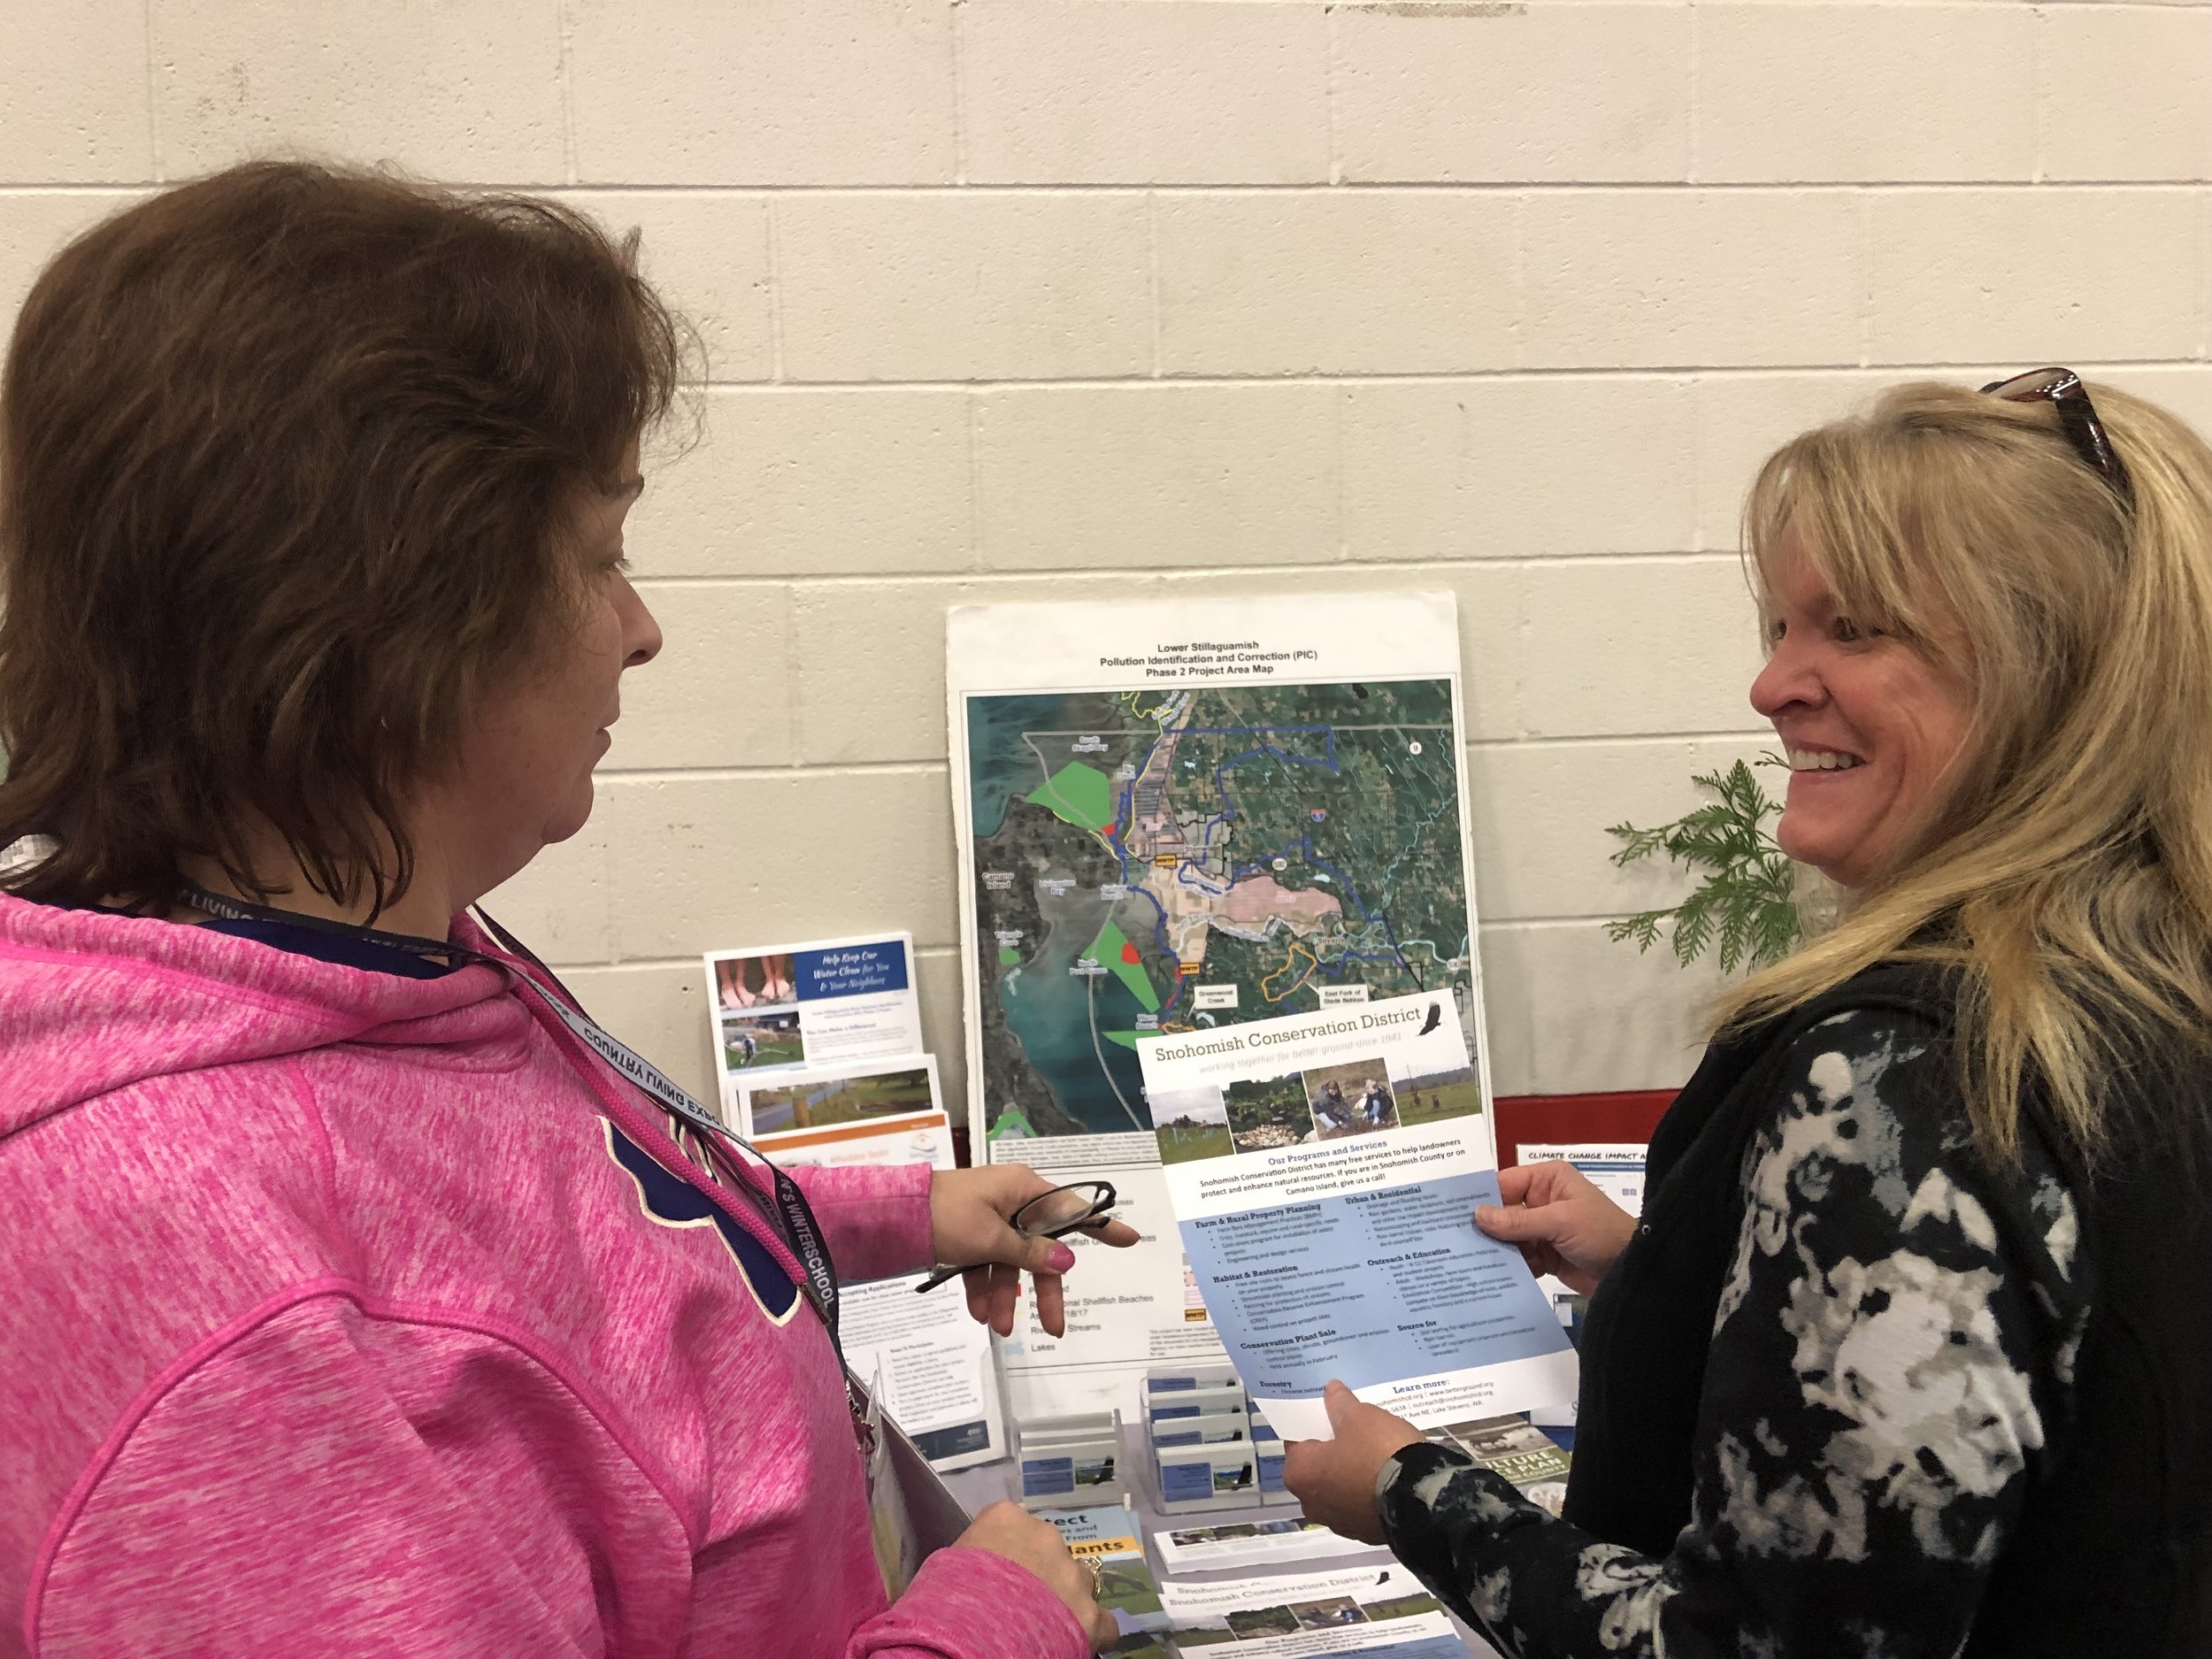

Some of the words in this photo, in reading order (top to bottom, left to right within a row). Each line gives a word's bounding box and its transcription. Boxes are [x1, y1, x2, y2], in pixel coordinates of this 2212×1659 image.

[1157, 644, 1188, 653] Lower
[1191, 641, 1259, 652] Stillaguamish
[1100, 657, 1145, 666] Pollution
[1148, 654, 1213, 665] Identification
[1216, 654, 1235, 663] and
[1237, 652, 1290, 662] Correction
[1293, 650, 1317, 661] (PIC)
[1146, 667, 1177, 677] Phase
[1179, 667, 1187, 676] 2
[1188, 666, 1224, 678] Project
[1226, 665, 1249, 674] Area
[1252, 664, 1273, 675] Map
[822, 953, 840, 966] Help
[841, 952, 860, 964] Keep
[862, 951, 878, 961] Our
[813, 970, 837, 979] Water
[839, 966, 861, 976] Clean
[1155, 1034, 1244, 1062] Snohomish
[1248, 1016, 1358, 1047] Conservation
[1360, 1006, 1420, 1029] District
[1198, 1059, 1235, 1075] working
[1267, 1156, 1286, 1165] Our
[1286, 1148, 1330, 1164] Programs
[1332, 1145, 1348, 1156] and
[1349, 1139, 1387, 1152] Services
[1200, 1174, 1239, 1187] Snohomish
[1240, 1167, 1286, 1180] Conservation
[1287, 1163, 1313, 1173] District
[1314, 1160, 1326, 1169] has
[1327, 1158, 1347, 1167] many
[1348, 1155, 1363, 1164] free
[1363, 1149, 1392, 1161] services
[1402, 1145, 1417, 1155] help
[1419, 1138, 1461, 1151] landowners
[1201, 1188, 1227, 1199] protect
[1242, 1180, 1273, 1191] enhance
[1274, 1176, 1299, 1186] natural
[1344, 1167, 1357, 1176] you
[1379, 1156, 1418, 1169] Snohomish
[1419, 1152, 1445, 1163] County
[1286, 1185, 1314, 1195] Camano
[1316, 1180, 1339, 1191] Island,
[1340, 1179, 1354, 1187] give
[1345, 1194, 1368, 1204] Urban
[1378, 1186, 1421, 1199] Residential
[1194, 1218, 1217, 1228] Farm
[1226, 1213, 1248, 1224] Rural
[1249, 1208, 1284, 1221] Property
[1286, 1202, 1321, 1216] Planning
[1367, 1255, 1403, 1266] Outreach
[1412, 1247, 1450, 1259] Education
[1212, 1272, 1242, 1284] Habitat
[1252, 1263, 1298, 1277] Restoration
[868, 1282, 906, 1292] Applications
[1082, 1297, 1117, 1306] Shellfish
[1118, 1294, 1154, 1304] Beaches
[1067, 1323, 1102, 1333] Streams
[1397, 1321, 1424, 1332] Source
[1031, 1343, 1056, 1352] Lakes
[1240, 1335, 1294, 1351] Conservation
[1294, 1333, 1317, 1342] Plant
[1317, 1328, 1336, 1337] Sale
[1393, 1382, 1421, 1394] Learn
[1517, 1458, 1563, 1472] PLAN
[1067, 1541, 1124, 1555] lants
[1169, 1594, 1240, 1607] Snohomish
[1241, 1581, 1327, 1599] Conservation
[1328, 1573, 1376, 1587] District
